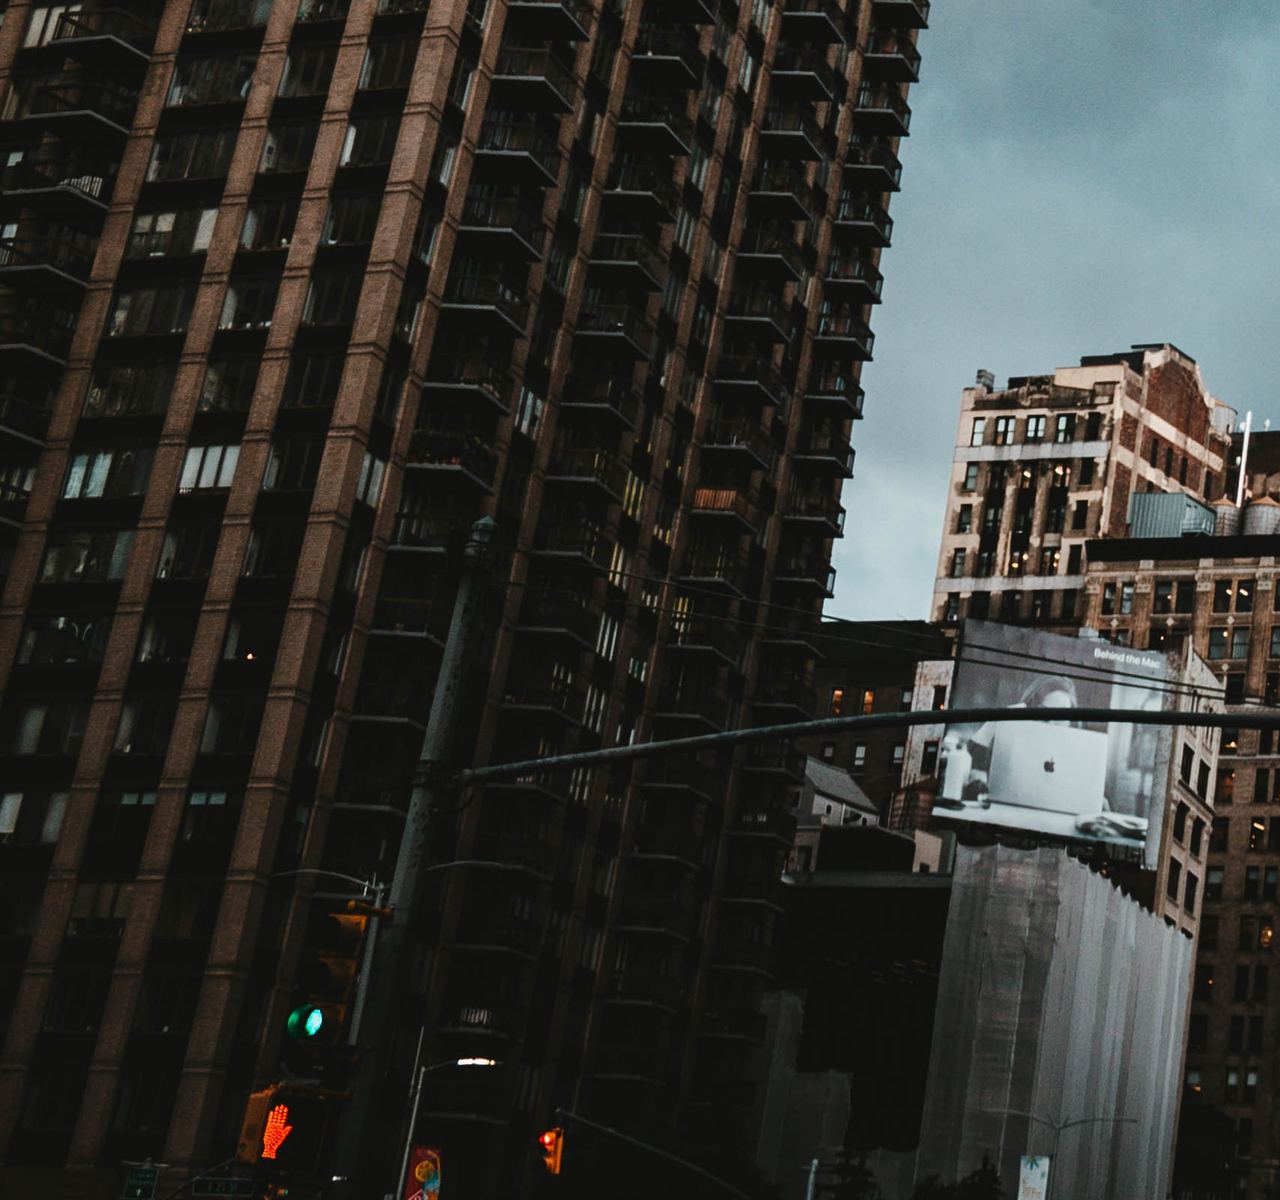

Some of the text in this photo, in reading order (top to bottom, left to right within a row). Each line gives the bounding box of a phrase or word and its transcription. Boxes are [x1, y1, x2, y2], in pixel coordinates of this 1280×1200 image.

[1094, 647, 1161, 669] Behind the Mac
